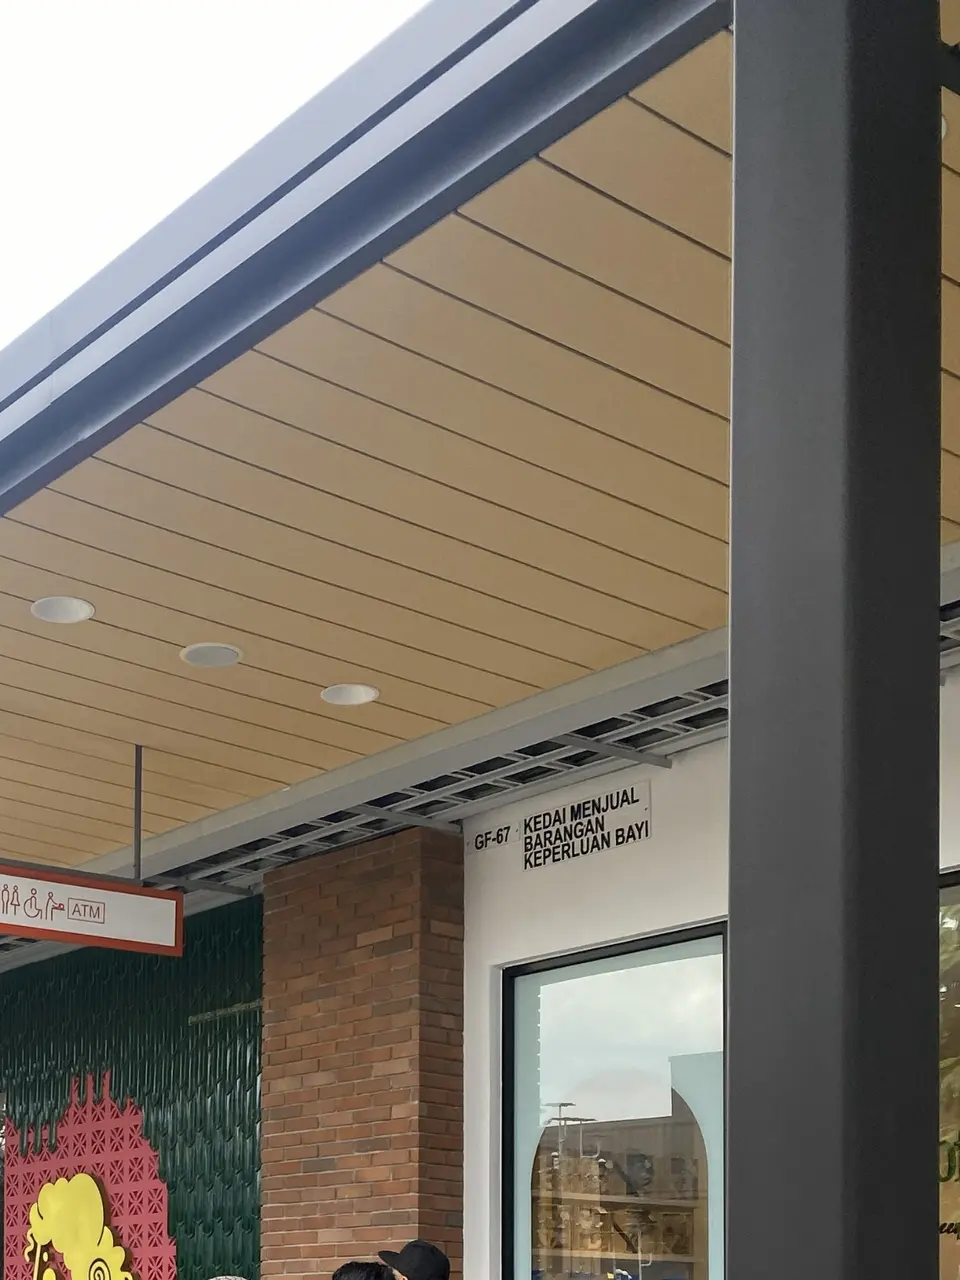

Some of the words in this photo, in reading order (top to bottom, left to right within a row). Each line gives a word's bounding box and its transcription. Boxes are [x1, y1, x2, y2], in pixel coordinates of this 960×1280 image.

[523, 807, 567, 835] KEDAI
[570, 786, 640, 823] MENJUAL
[474, 825, 511, 850] GF-67
[523, 832, 611, 870] KEPERLUAN
[615, 820, 649, 846] BAYI
[524, 816, 605, 853] BARANGAN
[72, 903, 101, 920] ATM
